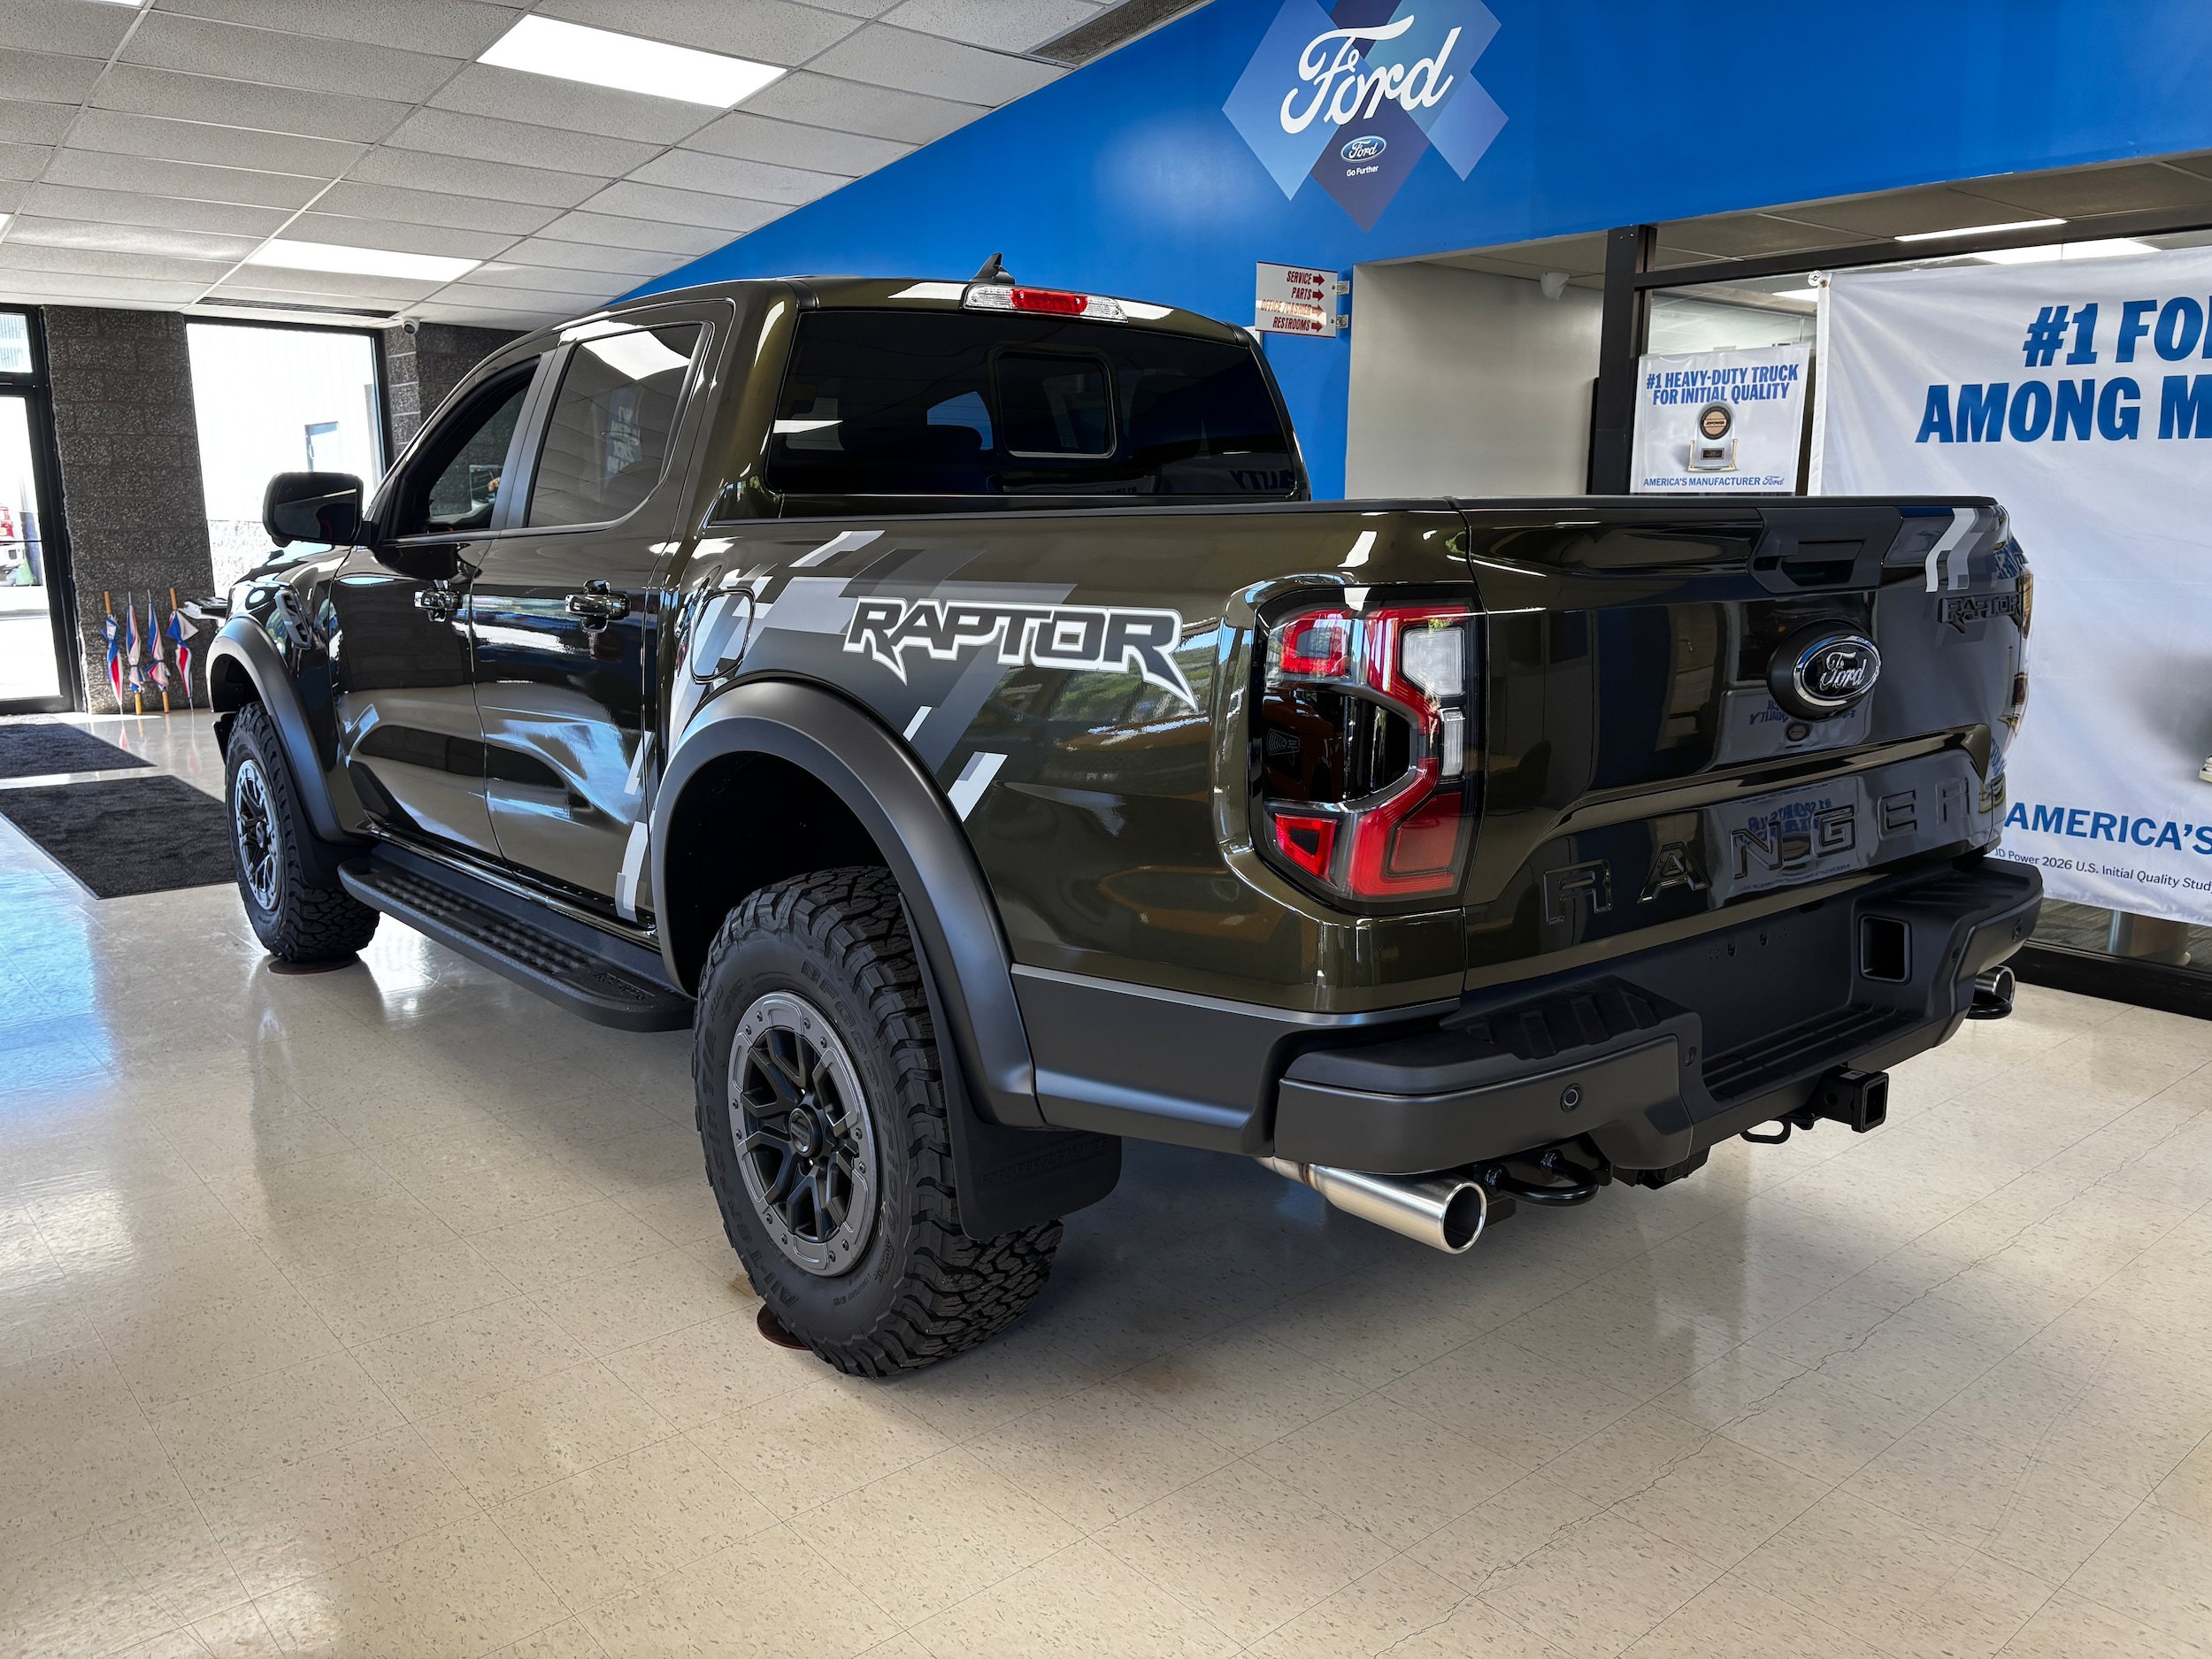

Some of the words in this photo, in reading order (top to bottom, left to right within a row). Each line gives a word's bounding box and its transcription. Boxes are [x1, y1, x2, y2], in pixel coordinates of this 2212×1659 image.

[1279, 14, 1462, 134] Ford
[1348, 139, 1379, 159] Ford
[1356, 165, 1379, 175] Further
[1286, 270, 1312, 285] SERVICE
[1291, 287, 1312, 300] PARTS
[1272, 316, 1311, 331] RESTROOMS
[2022, 303, 2099, 367] #1
[2116, 296, 2212, 363] FO
[1647, 373, 1662, 389] #1
[1664, 367, 1748, 388] HEAVY-DUTY
[1751, 364, 1799, 382] TRUCK
[1653, 388, 1678, 405] FOR
[1681, 385, 1727, 404] INITIAL
[1731, 382, 1790, 404] QUALITY
[1915, 377, 2141, 443] AMONG
[1643, 477, 1687, 487] AMERICA'S
[1688, 477, 1761, 486] MANUFACTURER
[1762, 475, 1785, 486] Ford
[1938, 594, 2022, 634] RAPTOR
[842, 595, 1199, 711] RAPTOR
[1819, 651, 1867, 691] Ford
[2004, 802, 2212, 856] AMERICA'S
[1543, 777, 1970, 926] RANGER
[1994, 848, 2006, 857] JD
[2008, 850, 2040, 864] Power
[2042, 856, 2073, 870] 2026
[2076, 861, 2100, 874] U.S.
[2101, 864, 2134, 879] Initial
[2137, 871, 2180, 888] Quality
[2182, 877, 2212, 894] Stud
